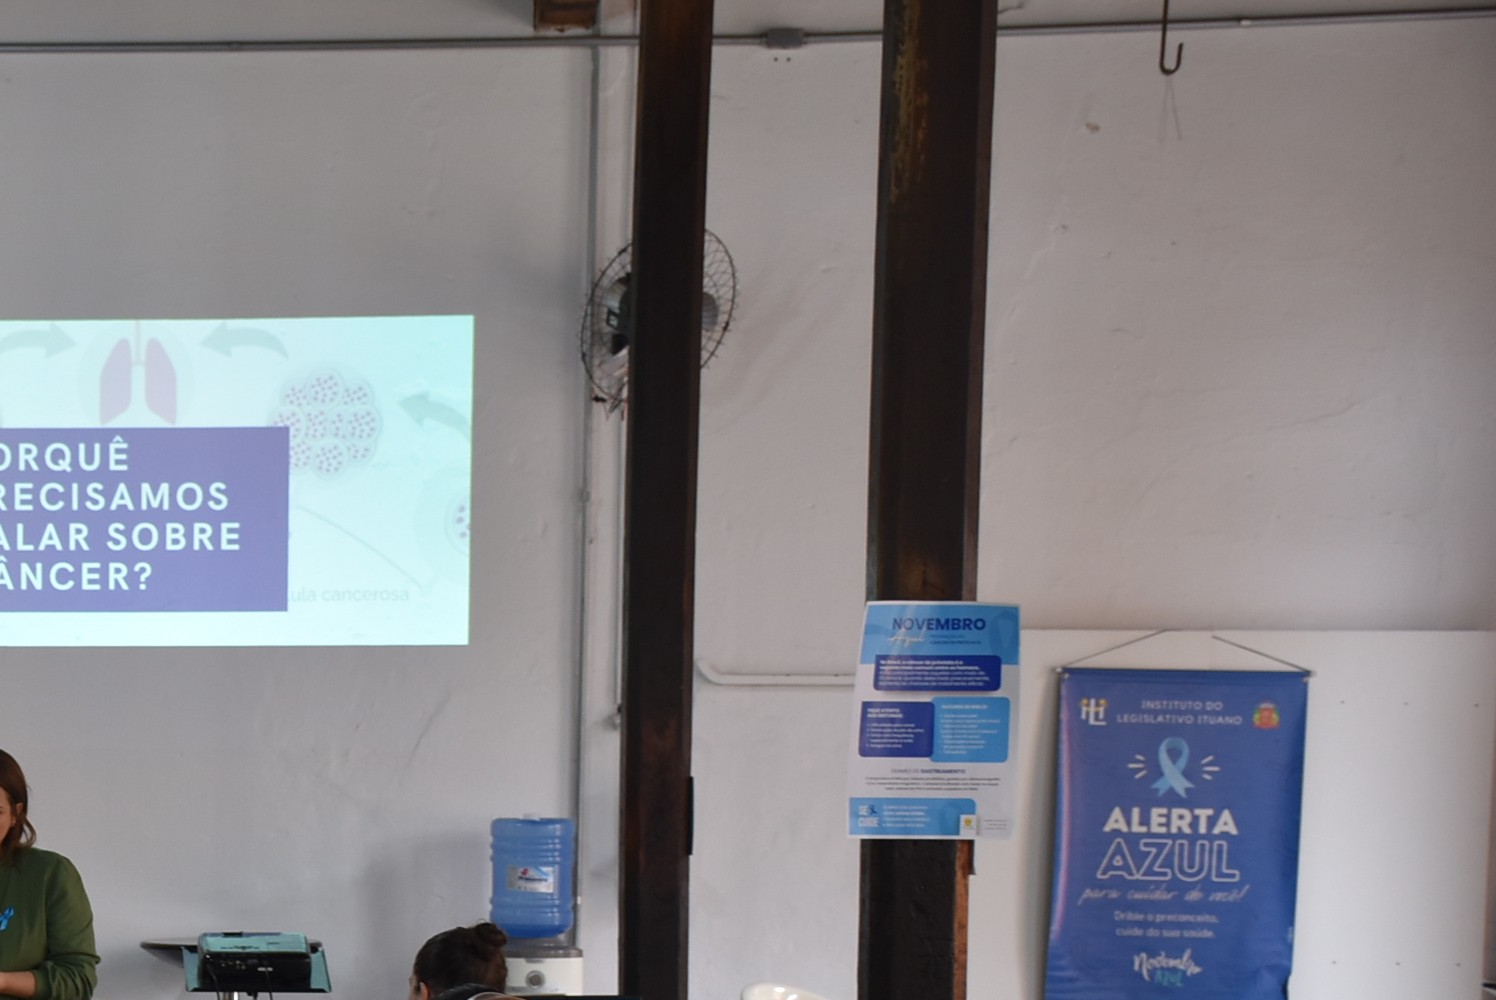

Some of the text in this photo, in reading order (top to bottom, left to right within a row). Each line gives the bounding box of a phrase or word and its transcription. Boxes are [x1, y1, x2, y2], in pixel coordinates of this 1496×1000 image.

[105, 522, 242, 552] SOBRE
[891, 617, 987, 631] NOVEMBRO
[1141, 699, 1224, 711] INSTITUTO DO
[1116, 713, 1243, 726] LEGISLATIVO ITUANO
[1103, 806, 1239, 836] ALERTA
[1096, 837, 1241, 883] AZUL
